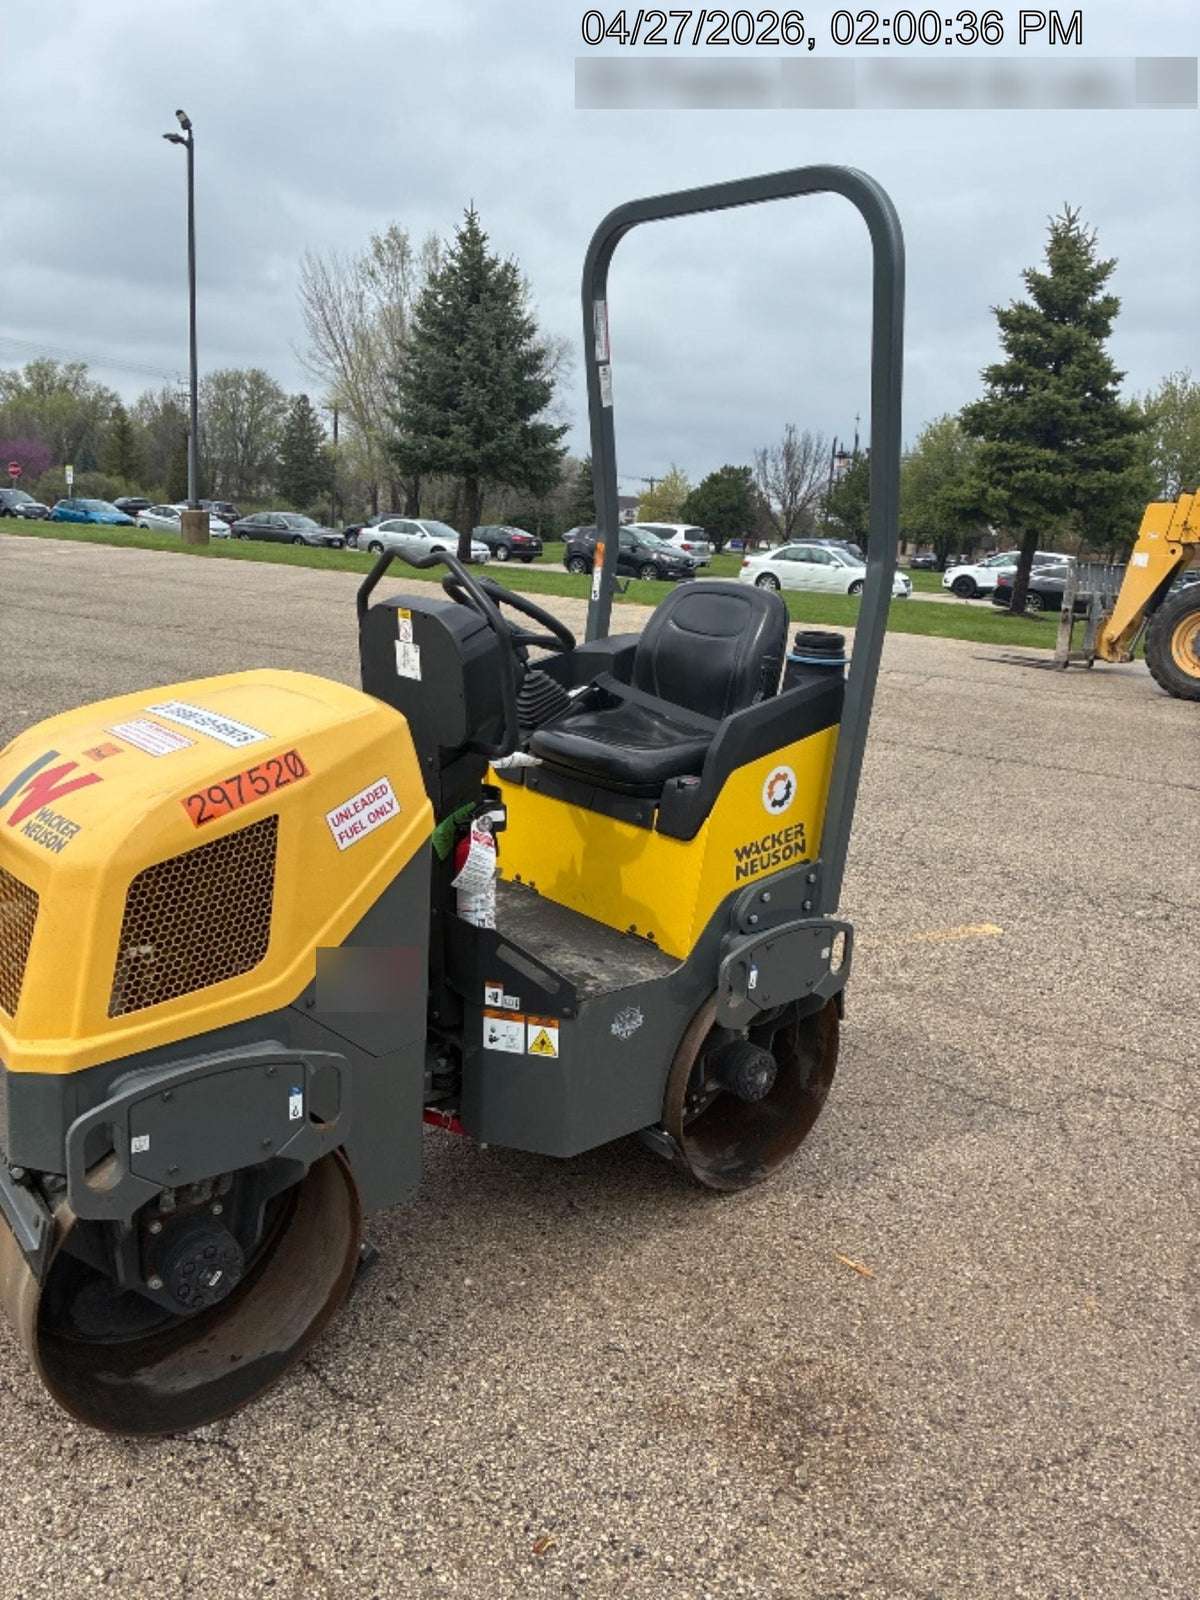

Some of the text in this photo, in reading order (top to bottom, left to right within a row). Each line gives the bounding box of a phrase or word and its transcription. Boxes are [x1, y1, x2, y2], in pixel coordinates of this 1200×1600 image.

[187, 751, 305, 825] 297520
[330, 783, 389, 828] UNLEADED
[20, 820, 70, 854] NEUSON
[35, 806, 82, 840] WACKER
[337, 798, 394, 844] FUEL ONLY
[734, 822, 806, 863] WACKER
[735, 838, 807, 881] NEUSON
